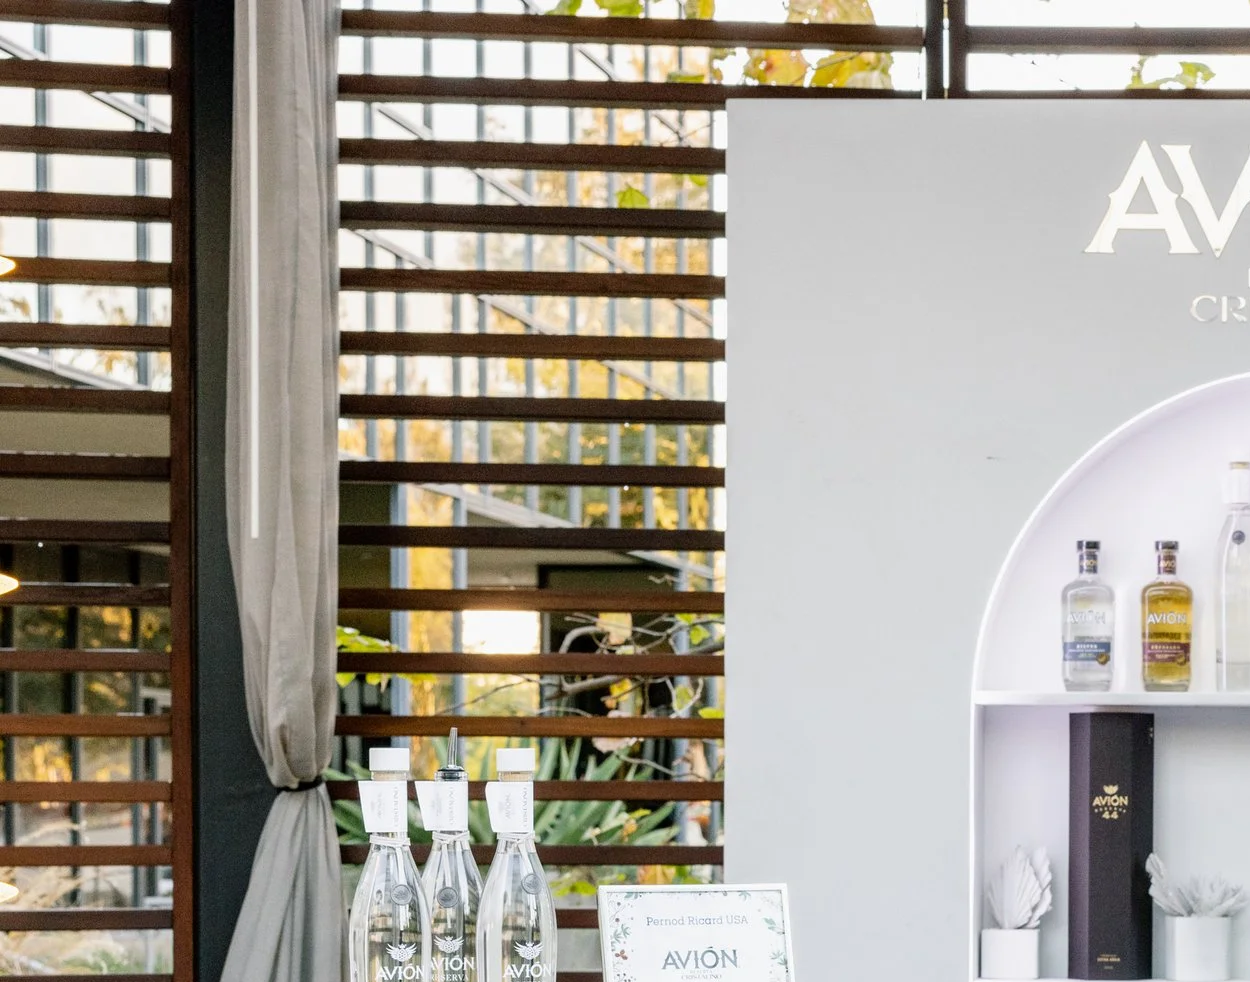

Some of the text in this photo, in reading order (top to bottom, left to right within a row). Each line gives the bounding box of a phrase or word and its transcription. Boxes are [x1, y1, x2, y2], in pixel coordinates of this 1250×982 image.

[646, 914, 749, 926] Pernod Ricard USA
[661, 946, 738, 970] AVIÓN
[375, 963, 424, 980] AVIÓN
[502, 961, 551, 978] AVIÓN
